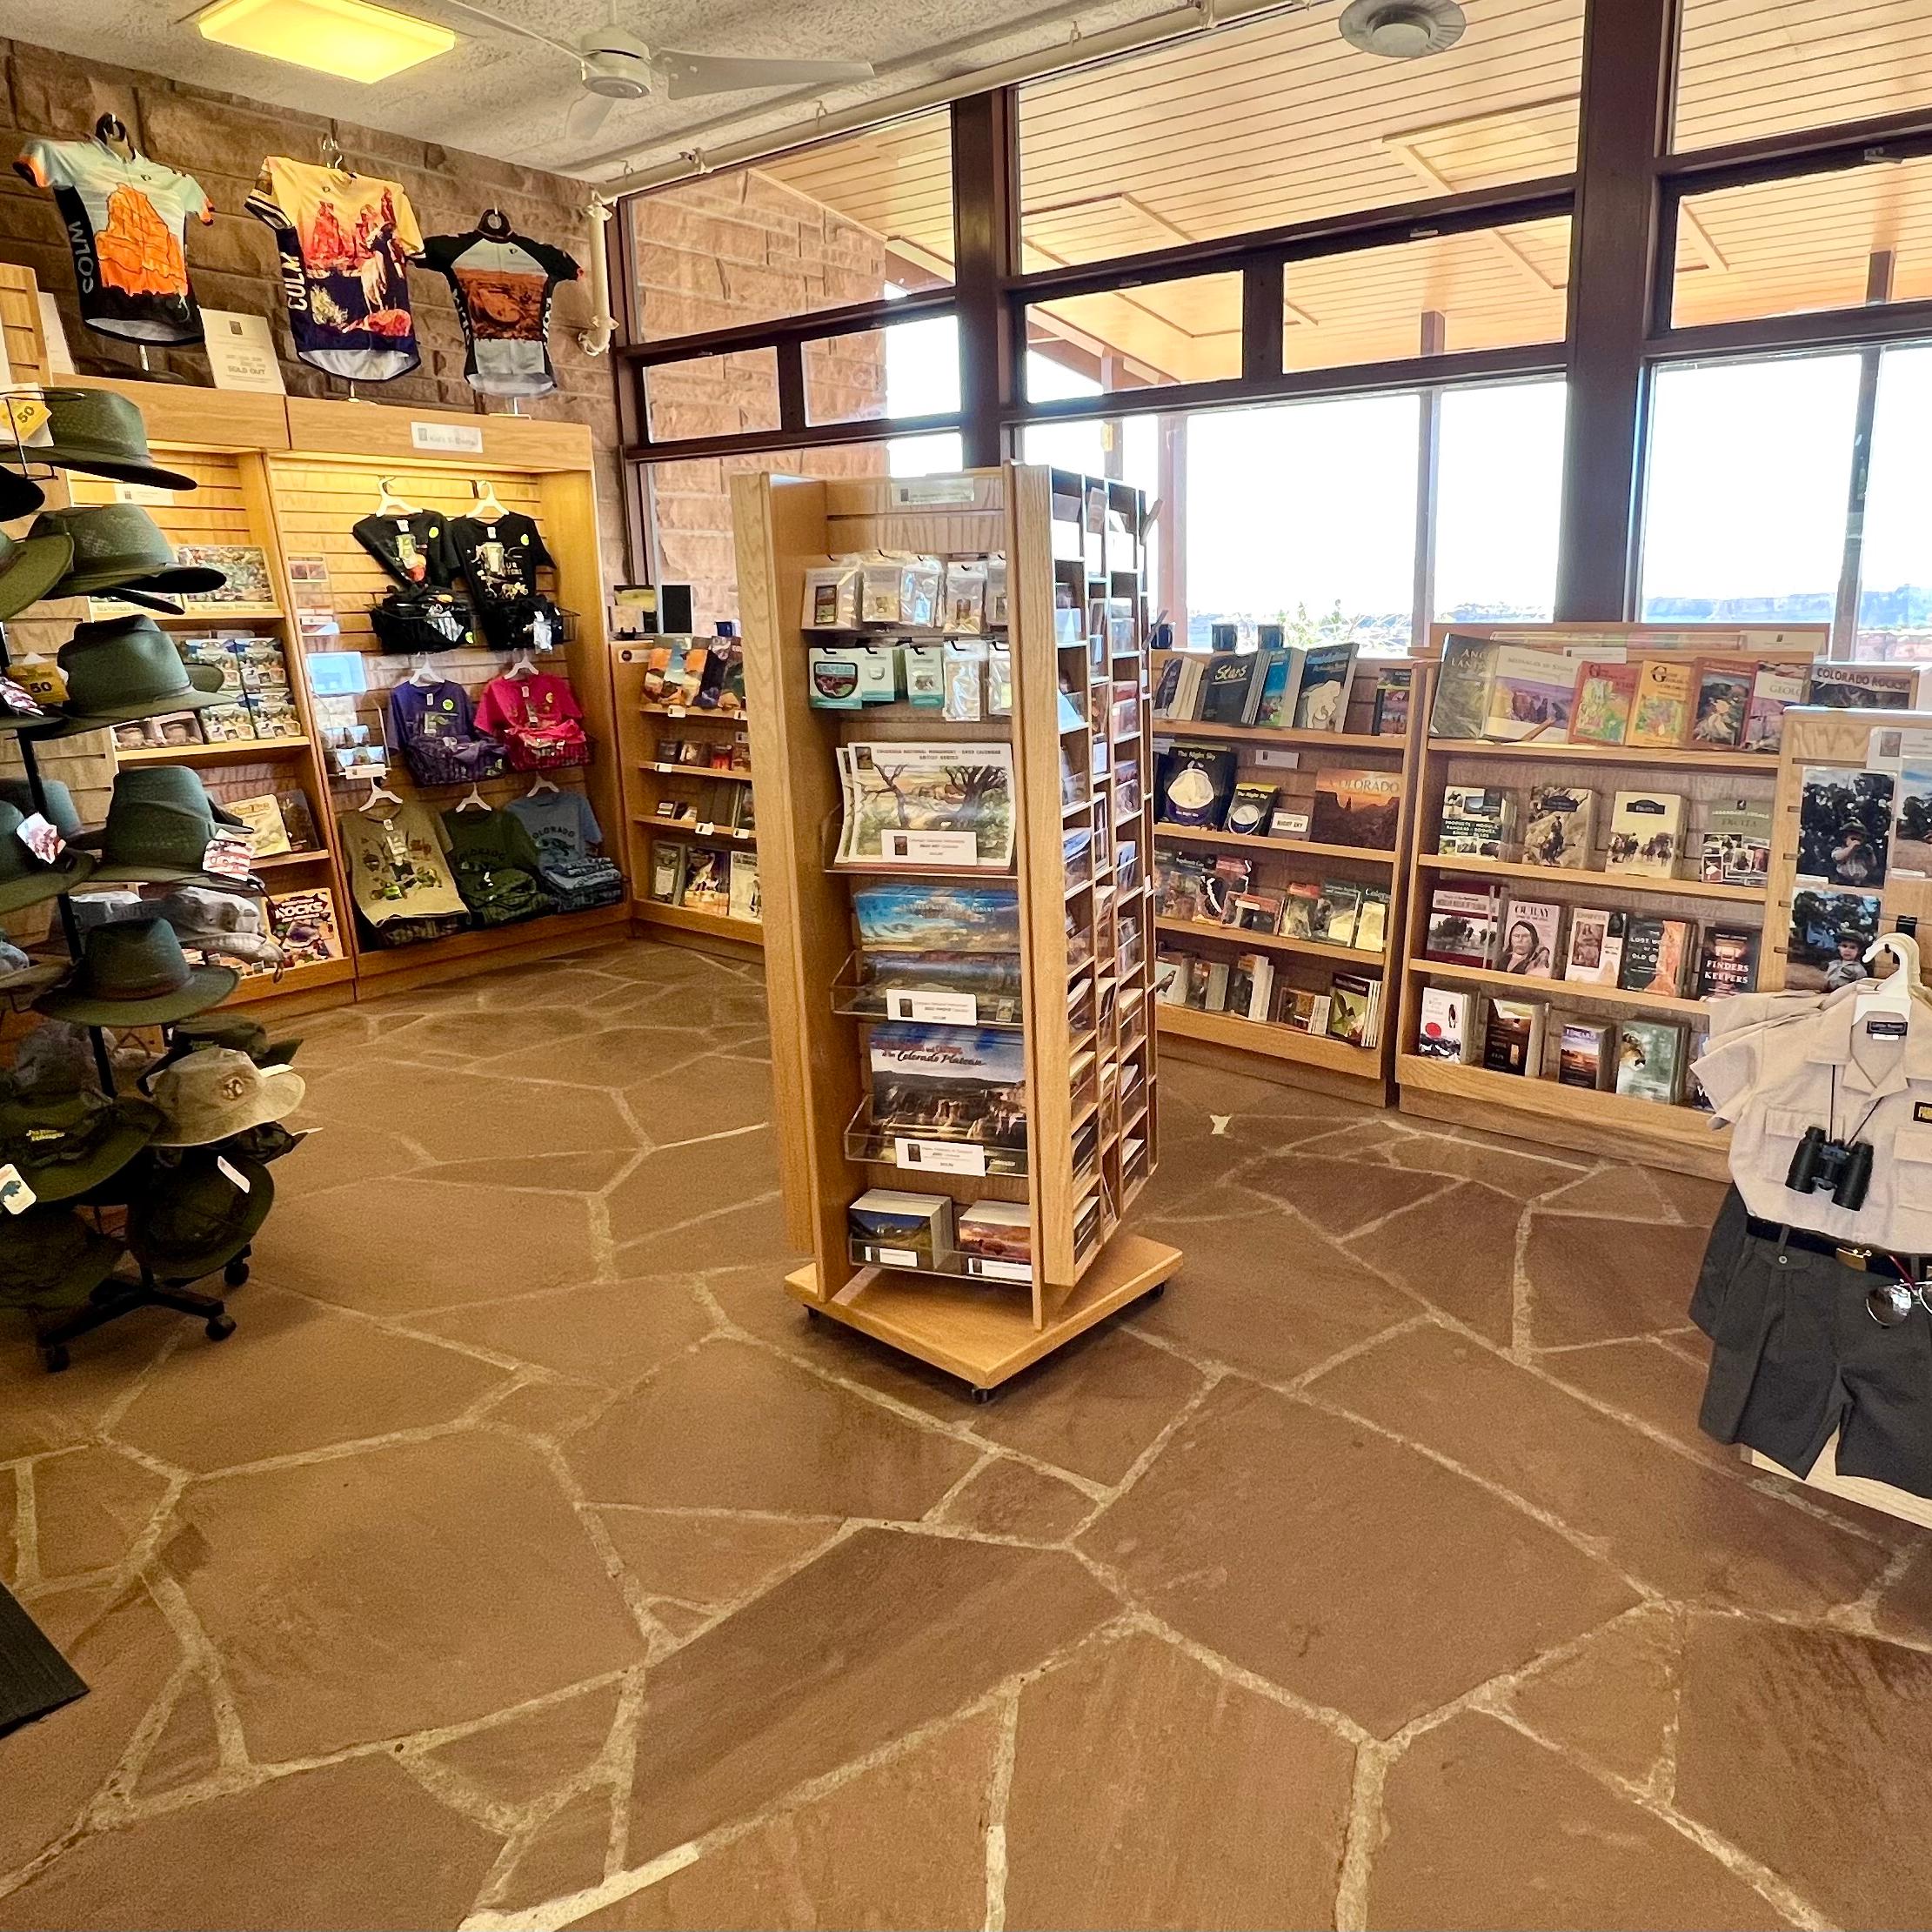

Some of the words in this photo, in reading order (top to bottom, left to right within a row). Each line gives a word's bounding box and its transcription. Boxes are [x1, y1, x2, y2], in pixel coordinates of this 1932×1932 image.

[17, 404, 36, 424] 50
[1816, 667, 1869, 685] COLORADO
[29, 681, 53, 693] 50
[1331, 779, 1400, 792] COLORADO
[531, 826, 576, 839] OLORADO
[1706, 959, 1749, 973] FINDERS
[1704, 971, 1748, 984] KEEPERS
[897, 1050, 939, 1062] Colorado
[939, 1053, 987, 1066] Plateau
